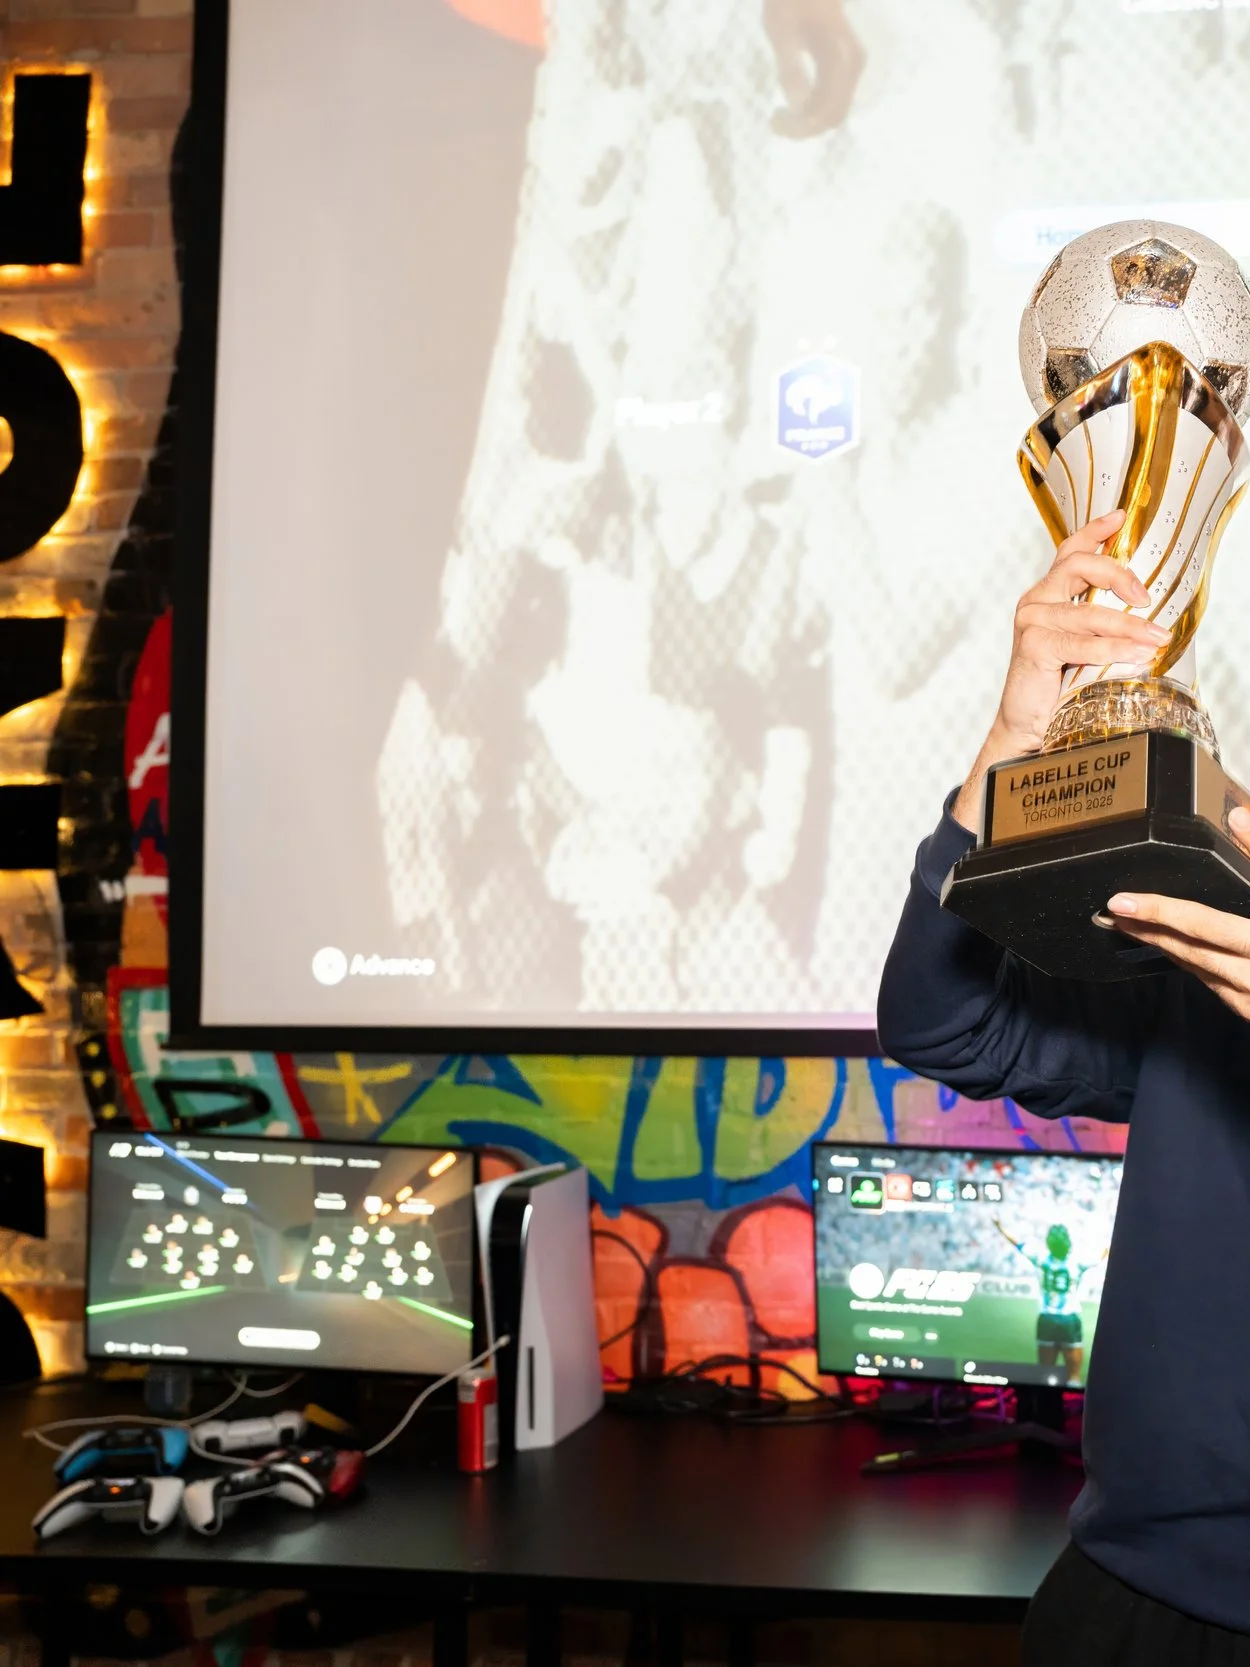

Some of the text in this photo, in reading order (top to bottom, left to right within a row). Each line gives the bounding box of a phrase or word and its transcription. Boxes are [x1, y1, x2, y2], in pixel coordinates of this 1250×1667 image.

[1036, 226, 1086, 245] Hom
[1010, 751, 1131, 793] LABELLE CUP
[1021, 775, 1117, 809] CHAMPION
[1024, 794, 1114, 825] TORONTO 2025
